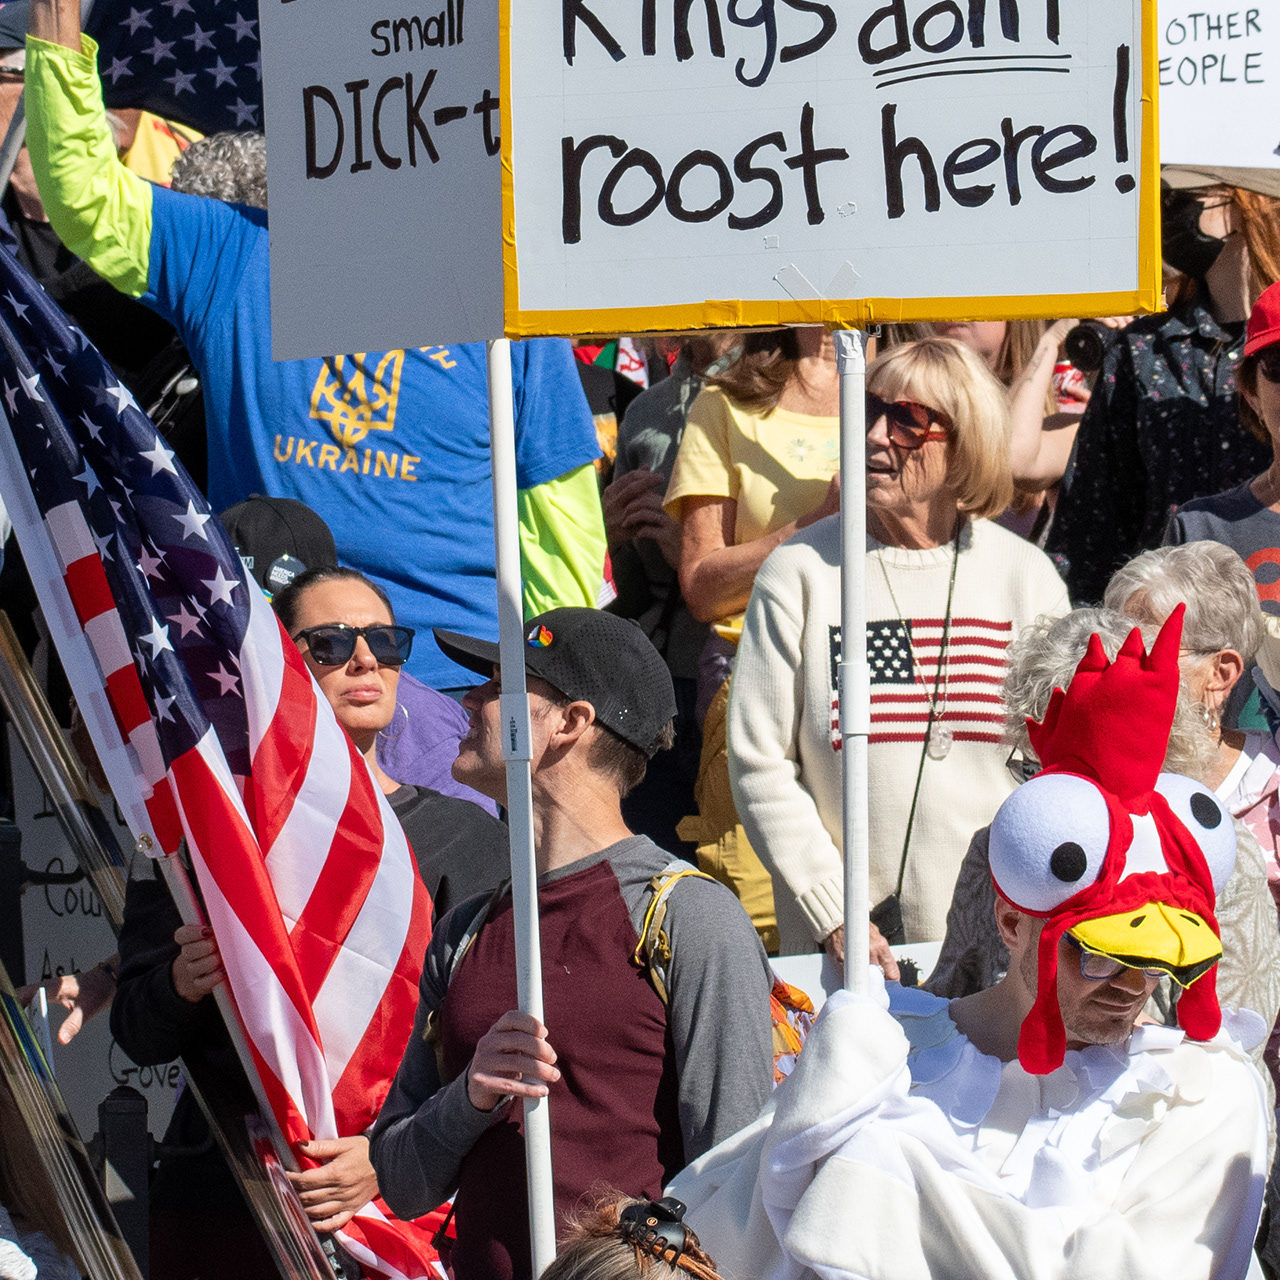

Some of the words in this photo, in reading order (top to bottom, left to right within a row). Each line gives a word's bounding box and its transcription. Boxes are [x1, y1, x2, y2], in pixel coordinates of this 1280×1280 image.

[1165, 8, 1263, 46] OTHER
[561, 101, 849, 245] roost
[880, 43, 1136, 219] here!
[273, 433, 422, 482] UKRAINE
